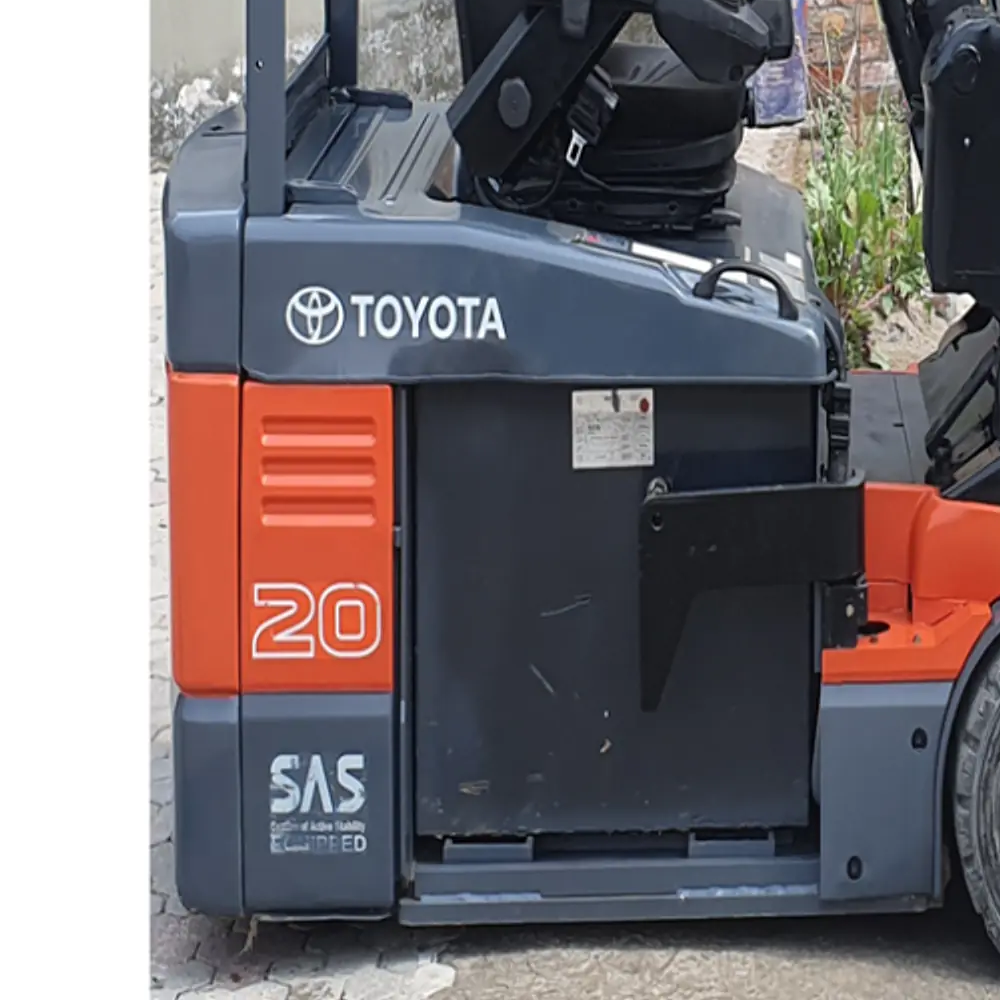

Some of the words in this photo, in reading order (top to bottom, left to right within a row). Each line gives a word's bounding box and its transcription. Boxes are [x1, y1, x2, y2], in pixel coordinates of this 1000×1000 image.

[350, 294, 506, 340] TOYOTA
[252, 582, 381, 659] 20
[270, 753, 365, 814] SAS
